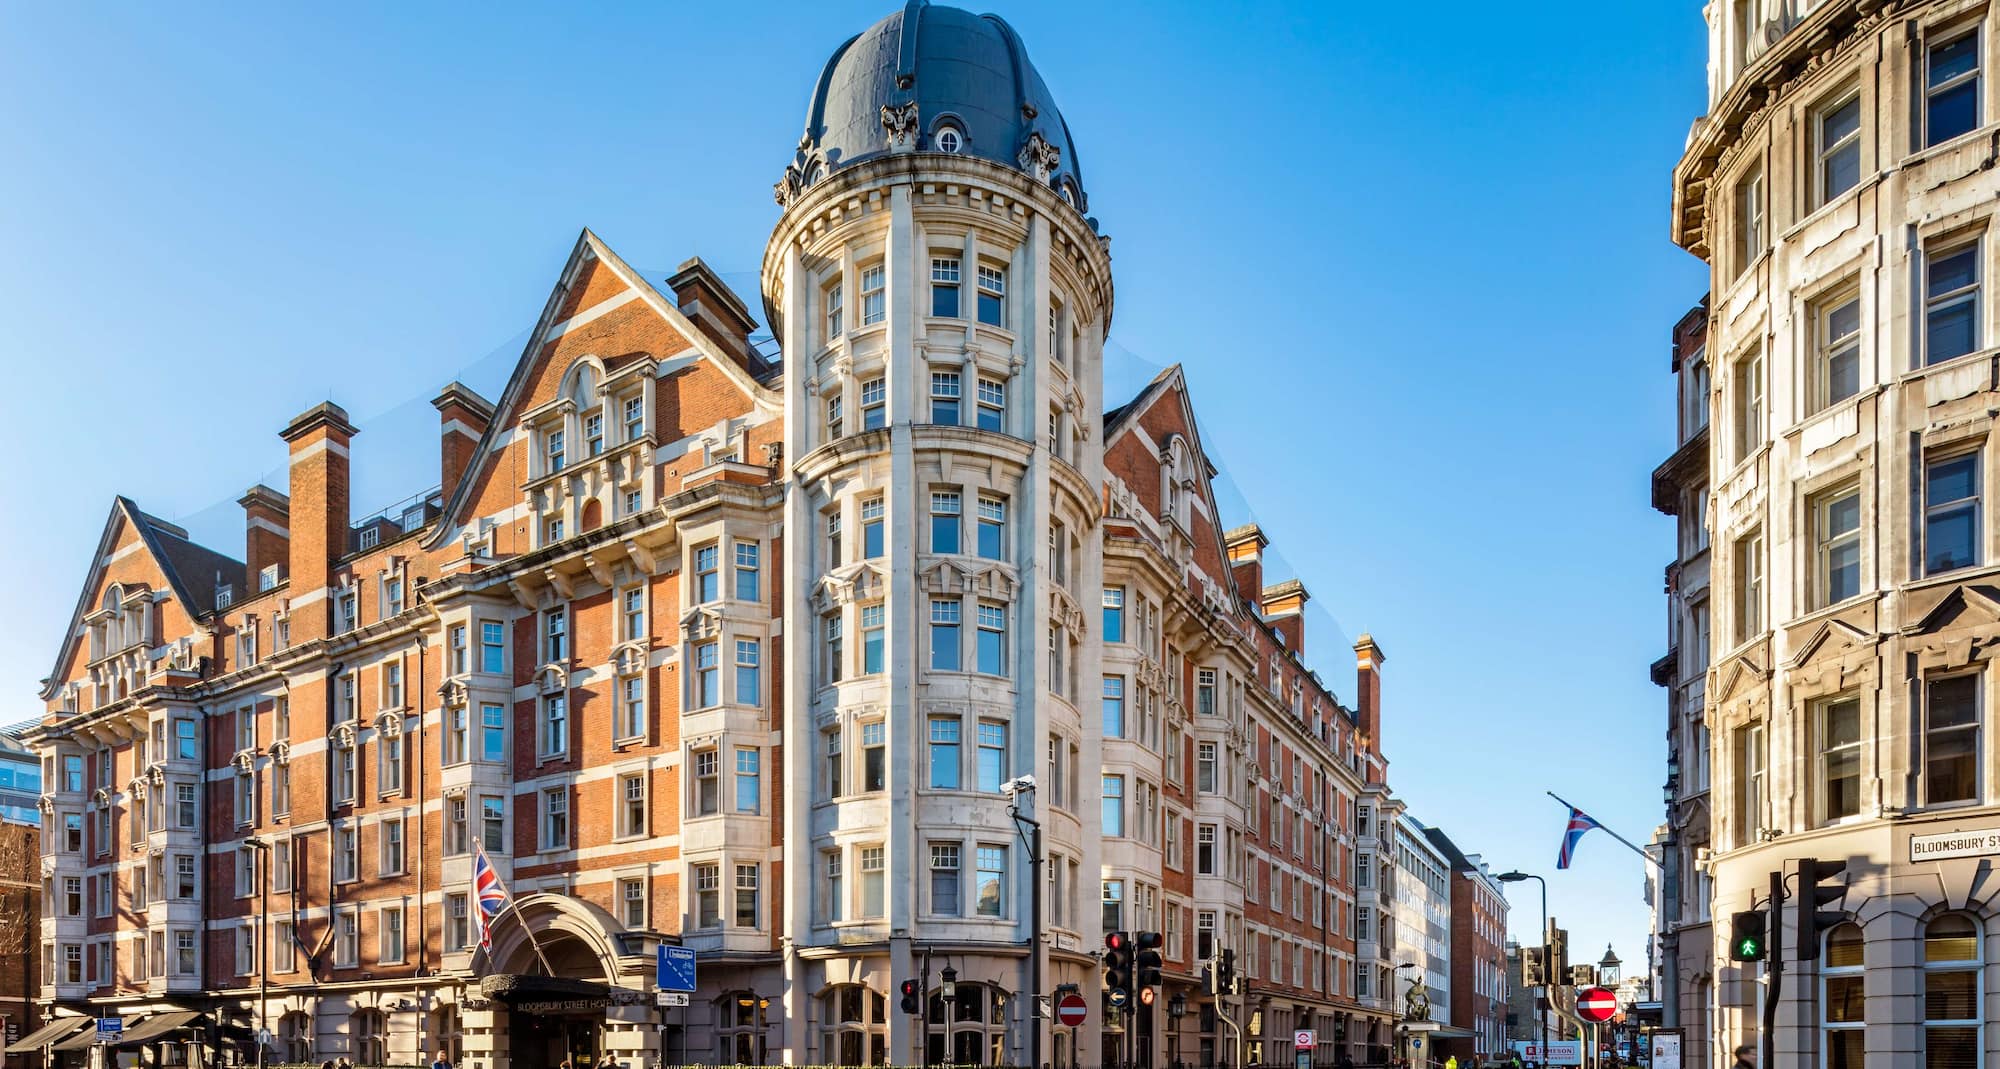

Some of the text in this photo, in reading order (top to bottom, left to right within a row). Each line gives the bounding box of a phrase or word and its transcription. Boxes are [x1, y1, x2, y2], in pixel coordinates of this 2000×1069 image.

[1914, 837, 1985, 854] BLOOMSBURY
[517, 1000, 562, 1012] BLOOMSBURY
[563, 999, 588, 1009] STREET
